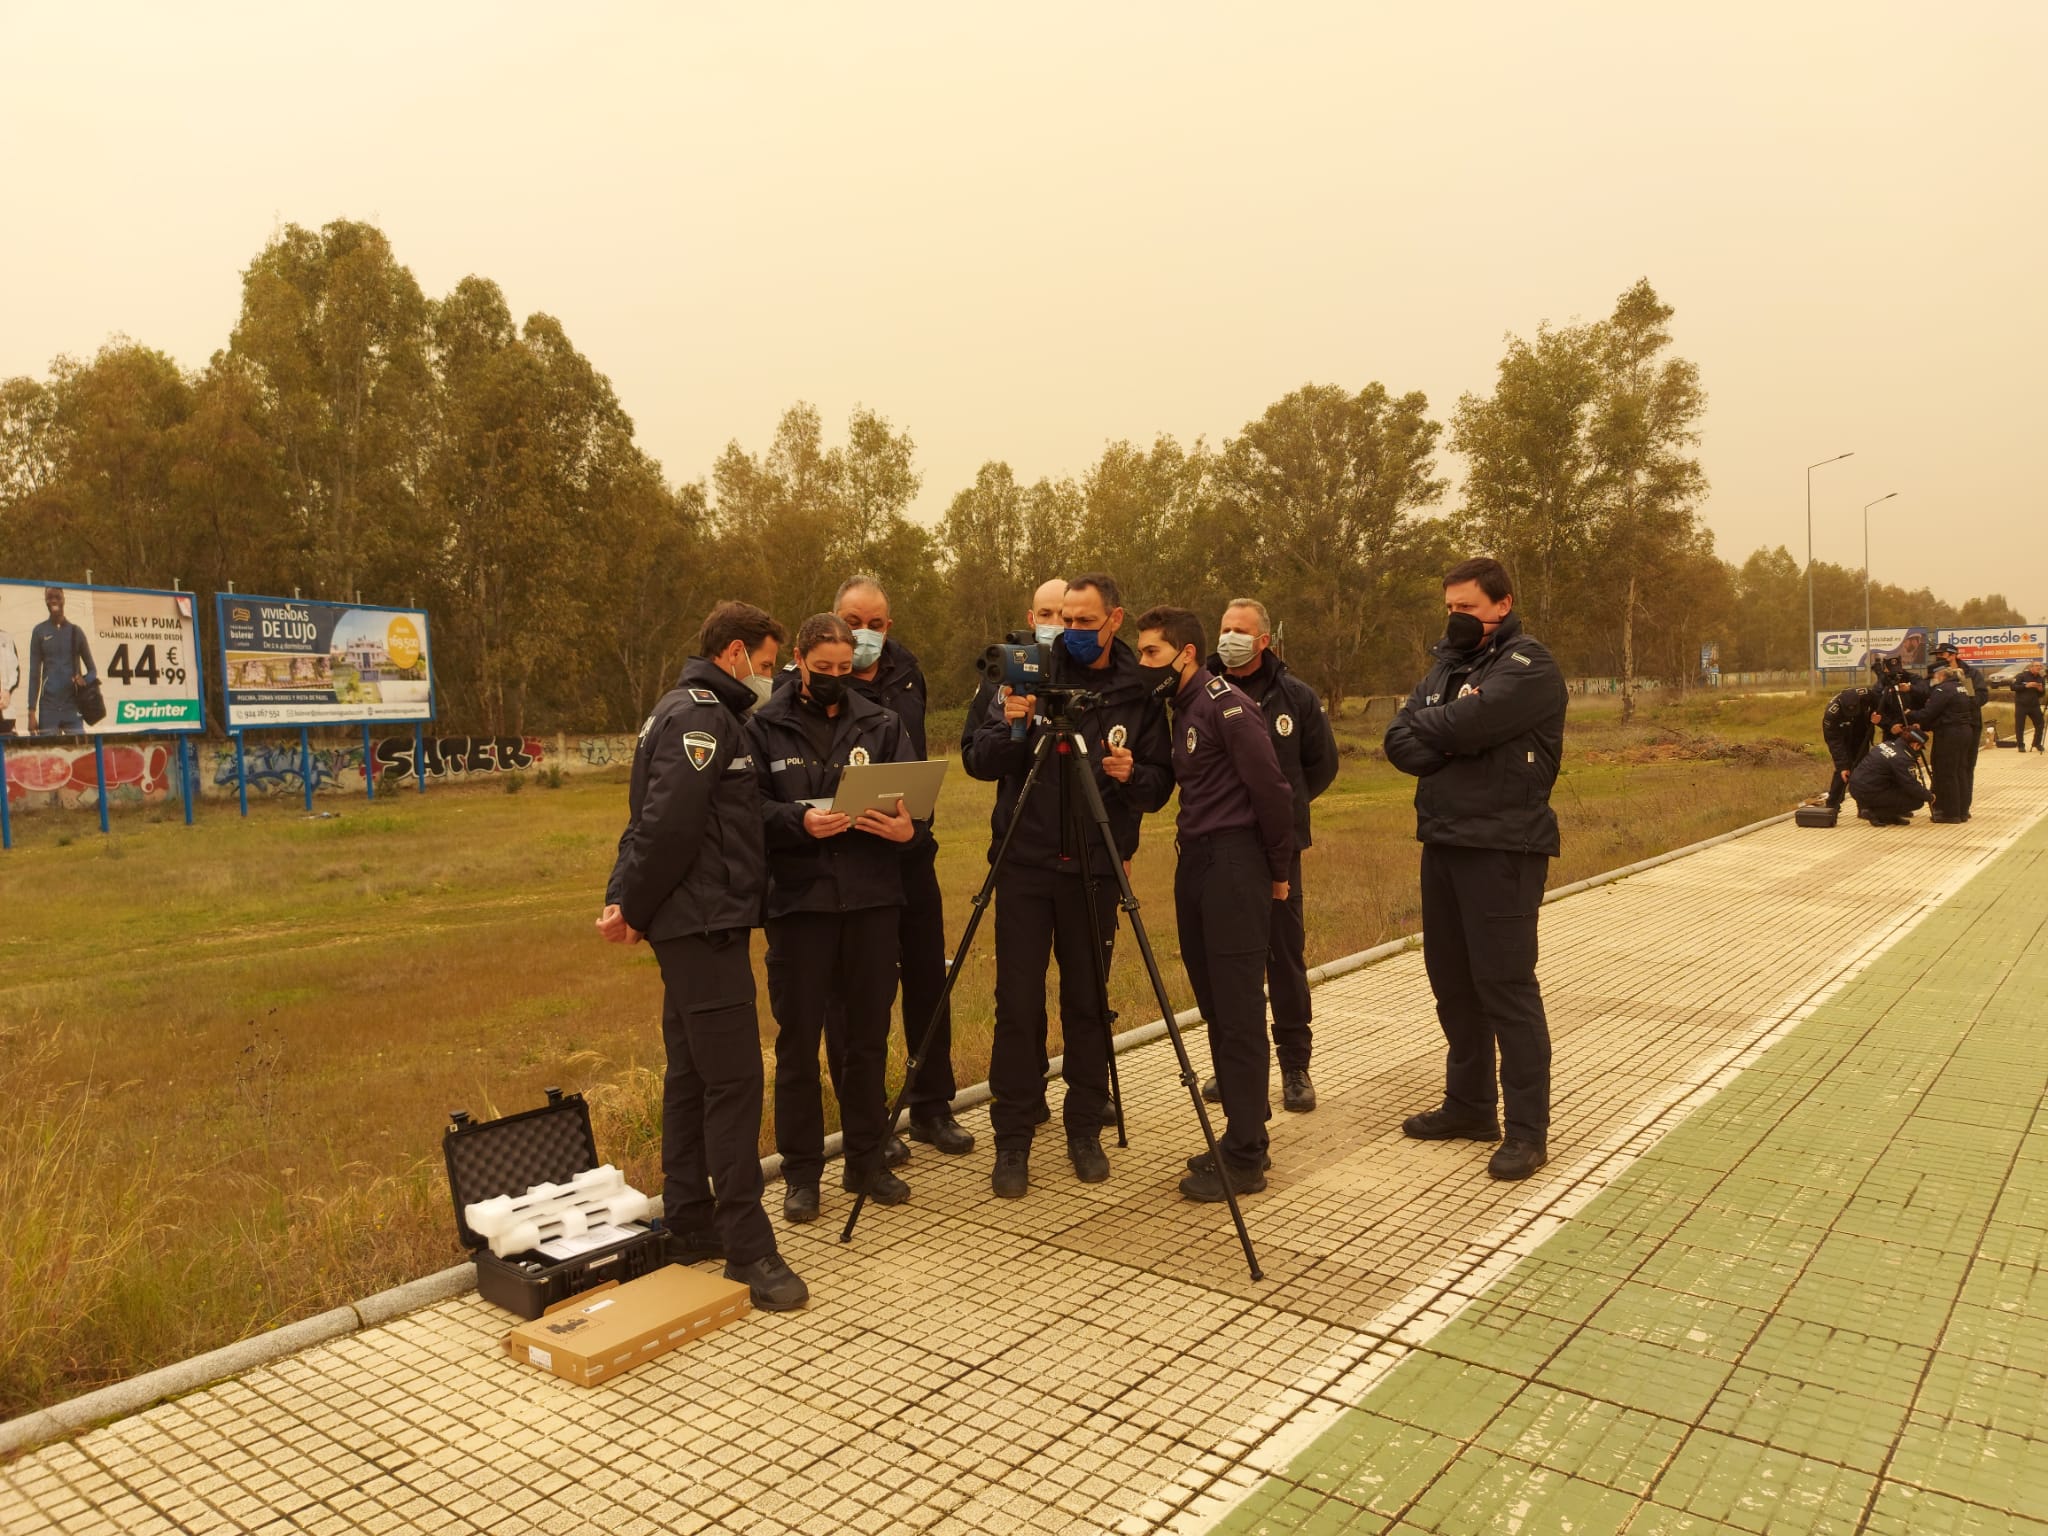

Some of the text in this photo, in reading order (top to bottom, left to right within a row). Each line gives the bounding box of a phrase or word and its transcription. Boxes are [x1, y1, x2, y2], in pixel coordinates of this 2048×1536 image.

[113, 615, 182, 629] NIKE Y PUMA
[261, 607, 309, 622] VIVIENDAS
[135, 632, 162, 640] HOMBRE
[164, 633, 183, 641] DESDE
[262, 620, 317, 643] DE LUJO
[1822, 634, 1853, 655] G3
[107, 643, 161, 685] 44
[123, 702, 187, 720] Sprinter
[377, 735, 535, 781] SATER
